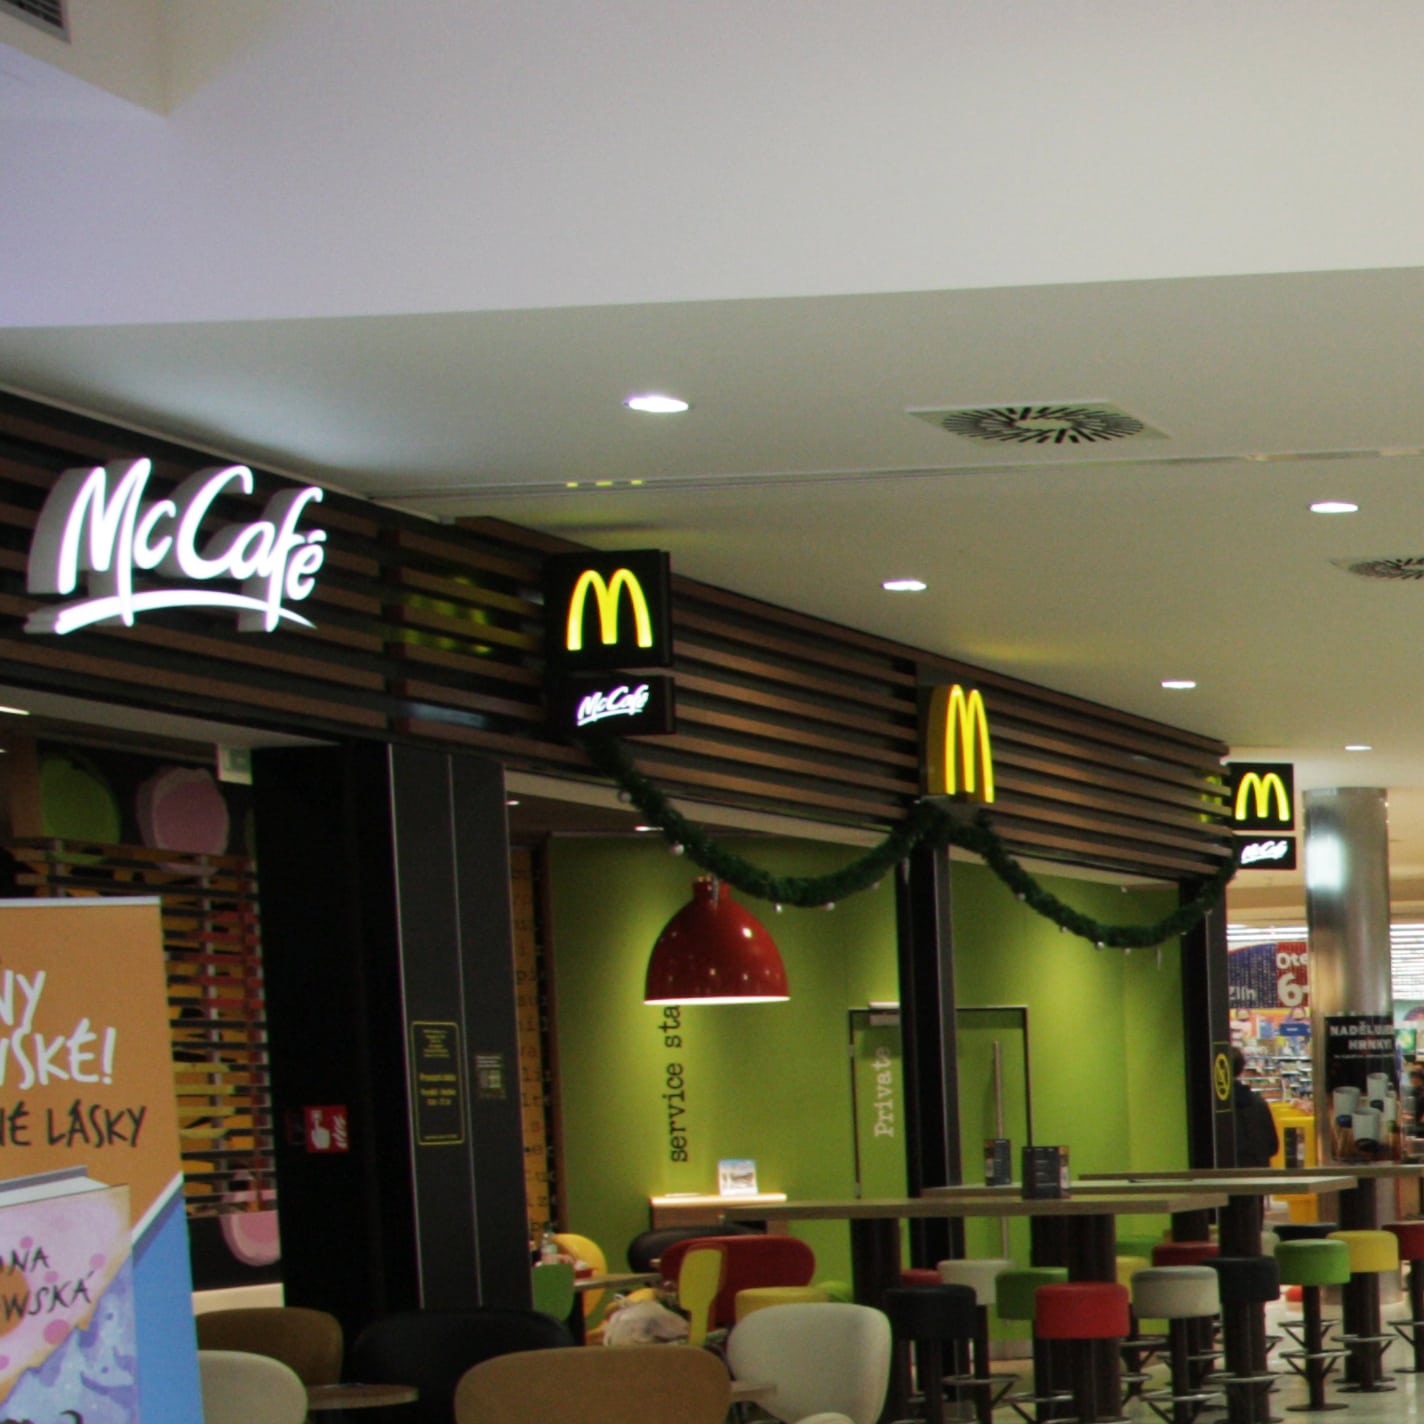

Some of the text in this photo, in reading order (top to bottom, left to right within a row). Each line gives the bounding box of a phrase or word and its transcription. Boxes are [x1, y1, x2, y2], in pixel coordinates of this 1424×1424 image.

[56, 457, 326, 633] McCafé
[0, 1018, 117, 1090] SKÉ!
[872, 1046, 894, 1137] Private
[47, 1099, 147, 1148] LÁSKY
[662, 1063, 688, 1163] service
